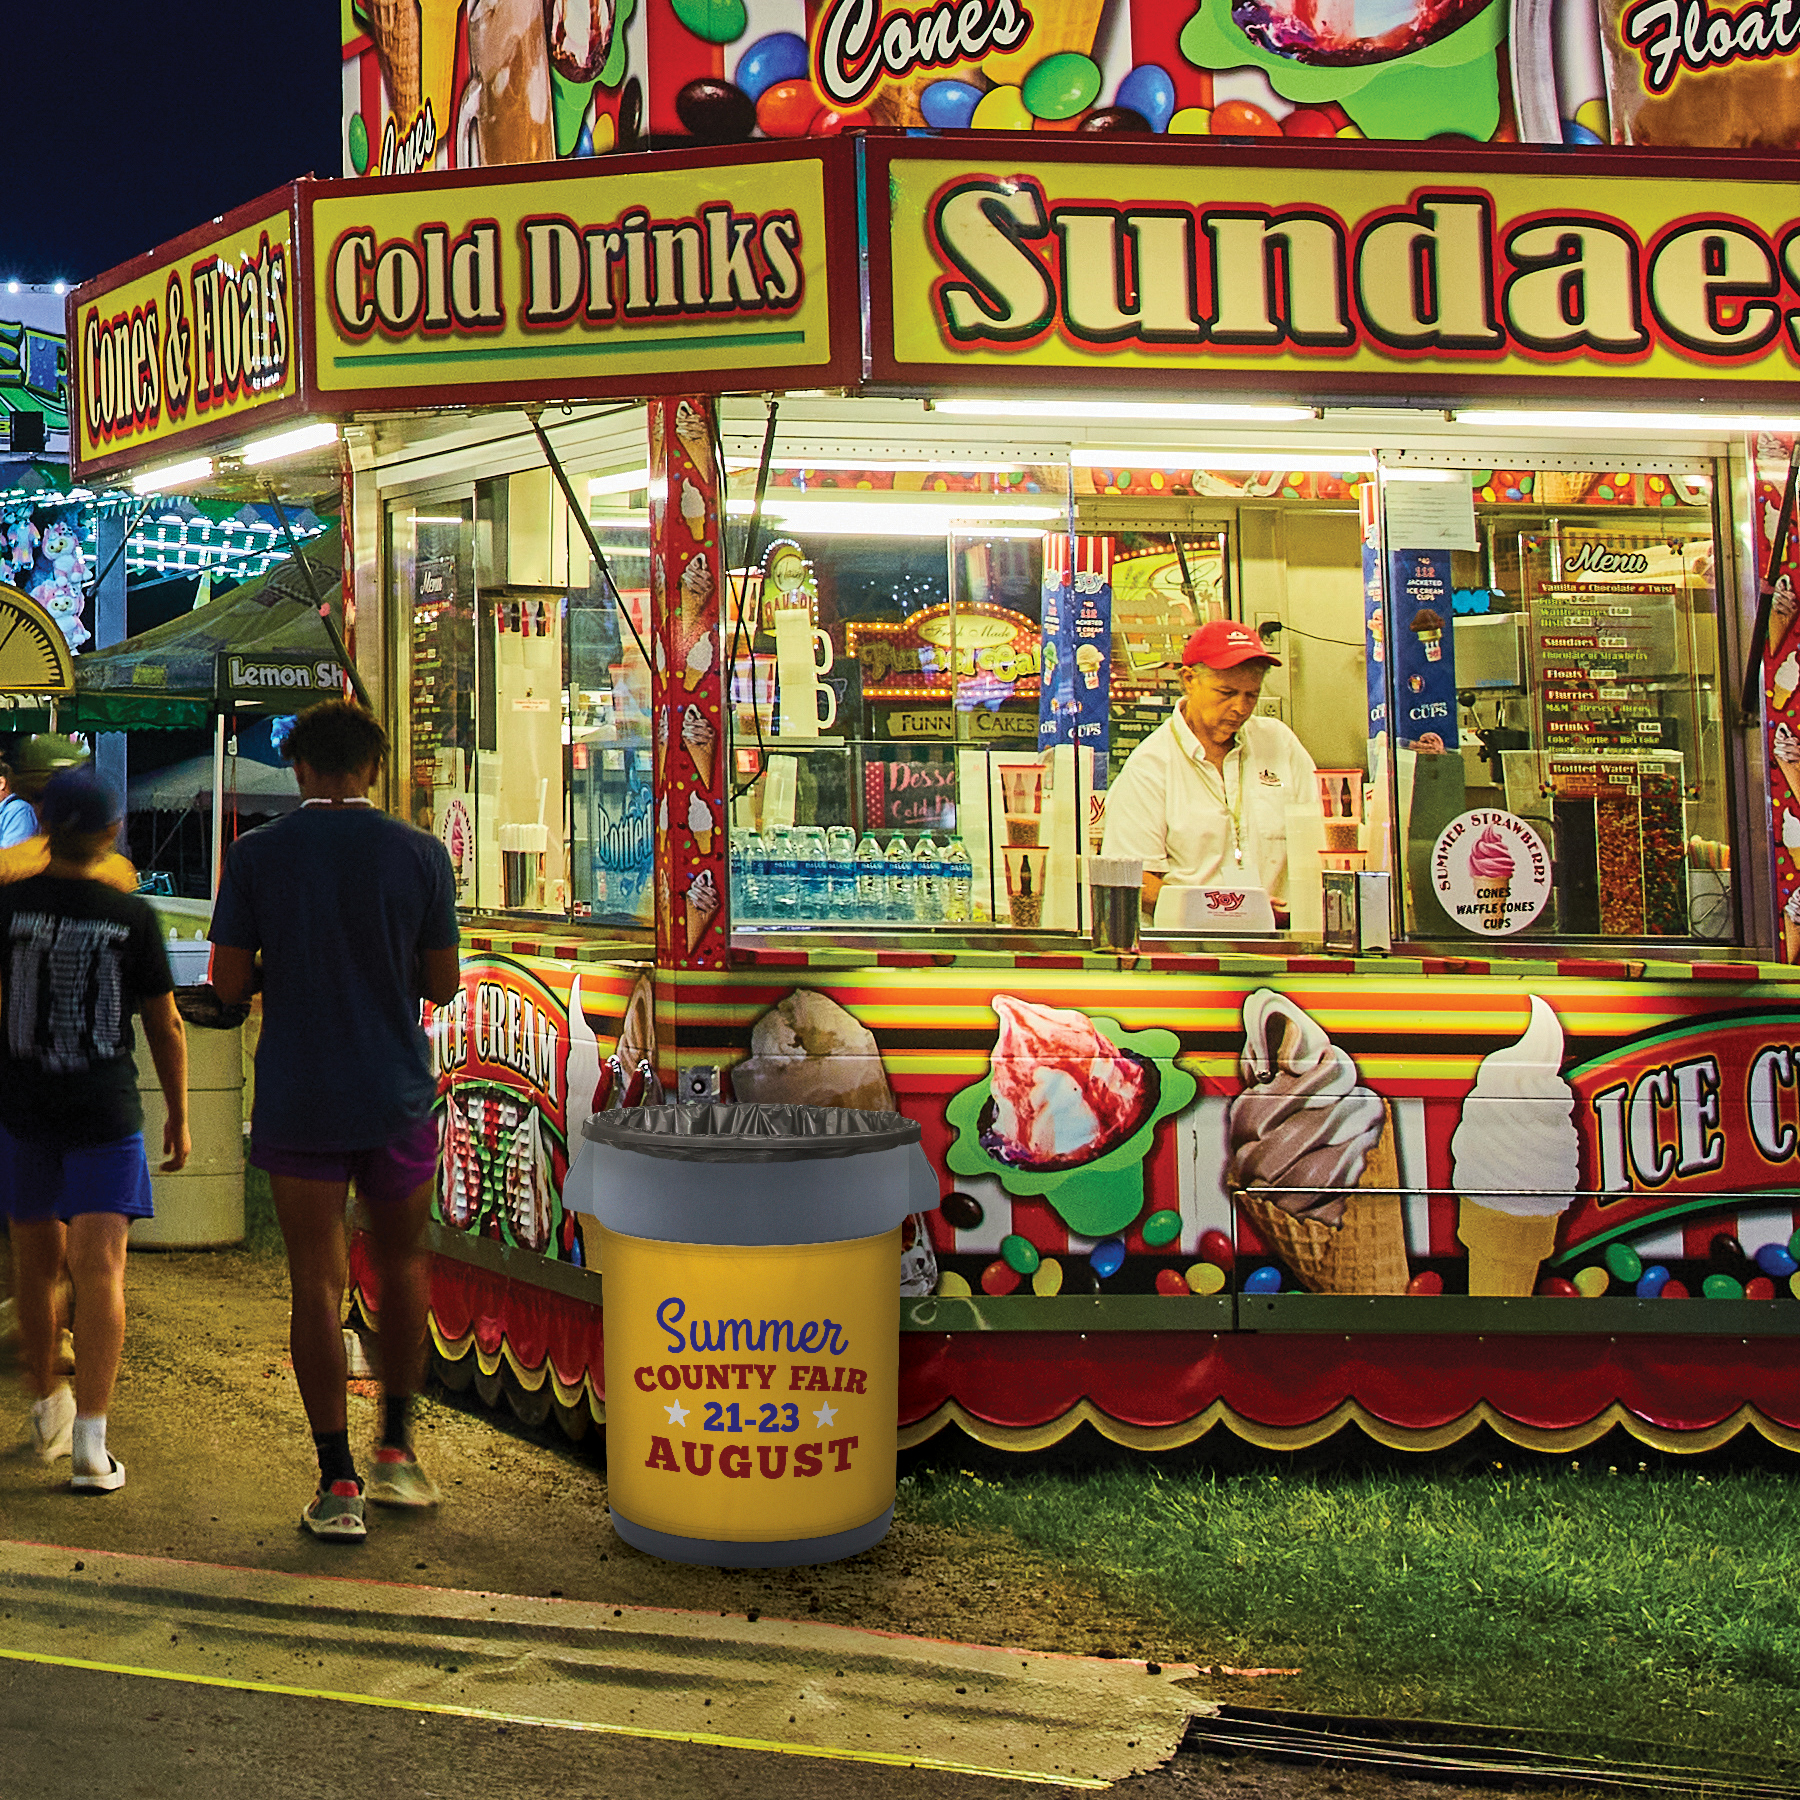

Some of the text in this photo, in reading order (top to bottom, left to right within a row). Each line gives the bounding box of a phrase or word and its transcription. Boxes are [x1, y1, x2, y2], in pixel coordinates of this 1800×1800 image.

[822, 0, 1027, 100] Cones
[1631, 0, 1800, 86] Float
[381, 105, 436, 176] Cones
[334, 210, 800, 326] Cold Drinks
[937, 188, 1800, 344] Sundae
[86, 311, 161, 429] Cones
[165, 282, 190, 401] &
[193, 243, 287, 393] Floats
[1414, 566, 1436, 578] 112
[1564, 543, 1649, 574] Menu
[1541, 583, 1674, 594] Vanilla Chocolate Twist
[1544, 637, 1595, 647] Sundaes
[231, 658, 311, 688] Lemon
[1547, 669, 1583, 679] Floats
[1548, 690, 1595, 700] Flurries
[901, 713, 1035, 733] FUNN CAKES
[1409, 705, 1448, 721] CUPS
[1550, 722, 1590, 732] Drinks
[1553, 764, 1597, 773] Bottled
[1600, 765, 1636, 774] Water
[891, 798, 928, 818] Cold
[1436, 812, 1545, 891] SUMMER STRAWBERRY
[1204, 890, 1246, 911] JOY
[1476, 886, 1512, 899] CONES
[1456, 901, 1535, 915] WAFFLE CONES
[1483, 917, 1511, 930] CUPS
[474, 984, 558, 1103] CREAM
[1595, 1048, 1800, 1193] ICE C
[655, 1296, 850, 1356] Summer
[633, 1363, 868, 1395] COUNTY FAIR
[703, 1401, 800, 1433] 21-23
[644, 1434, 859, 1480] AUGUST
